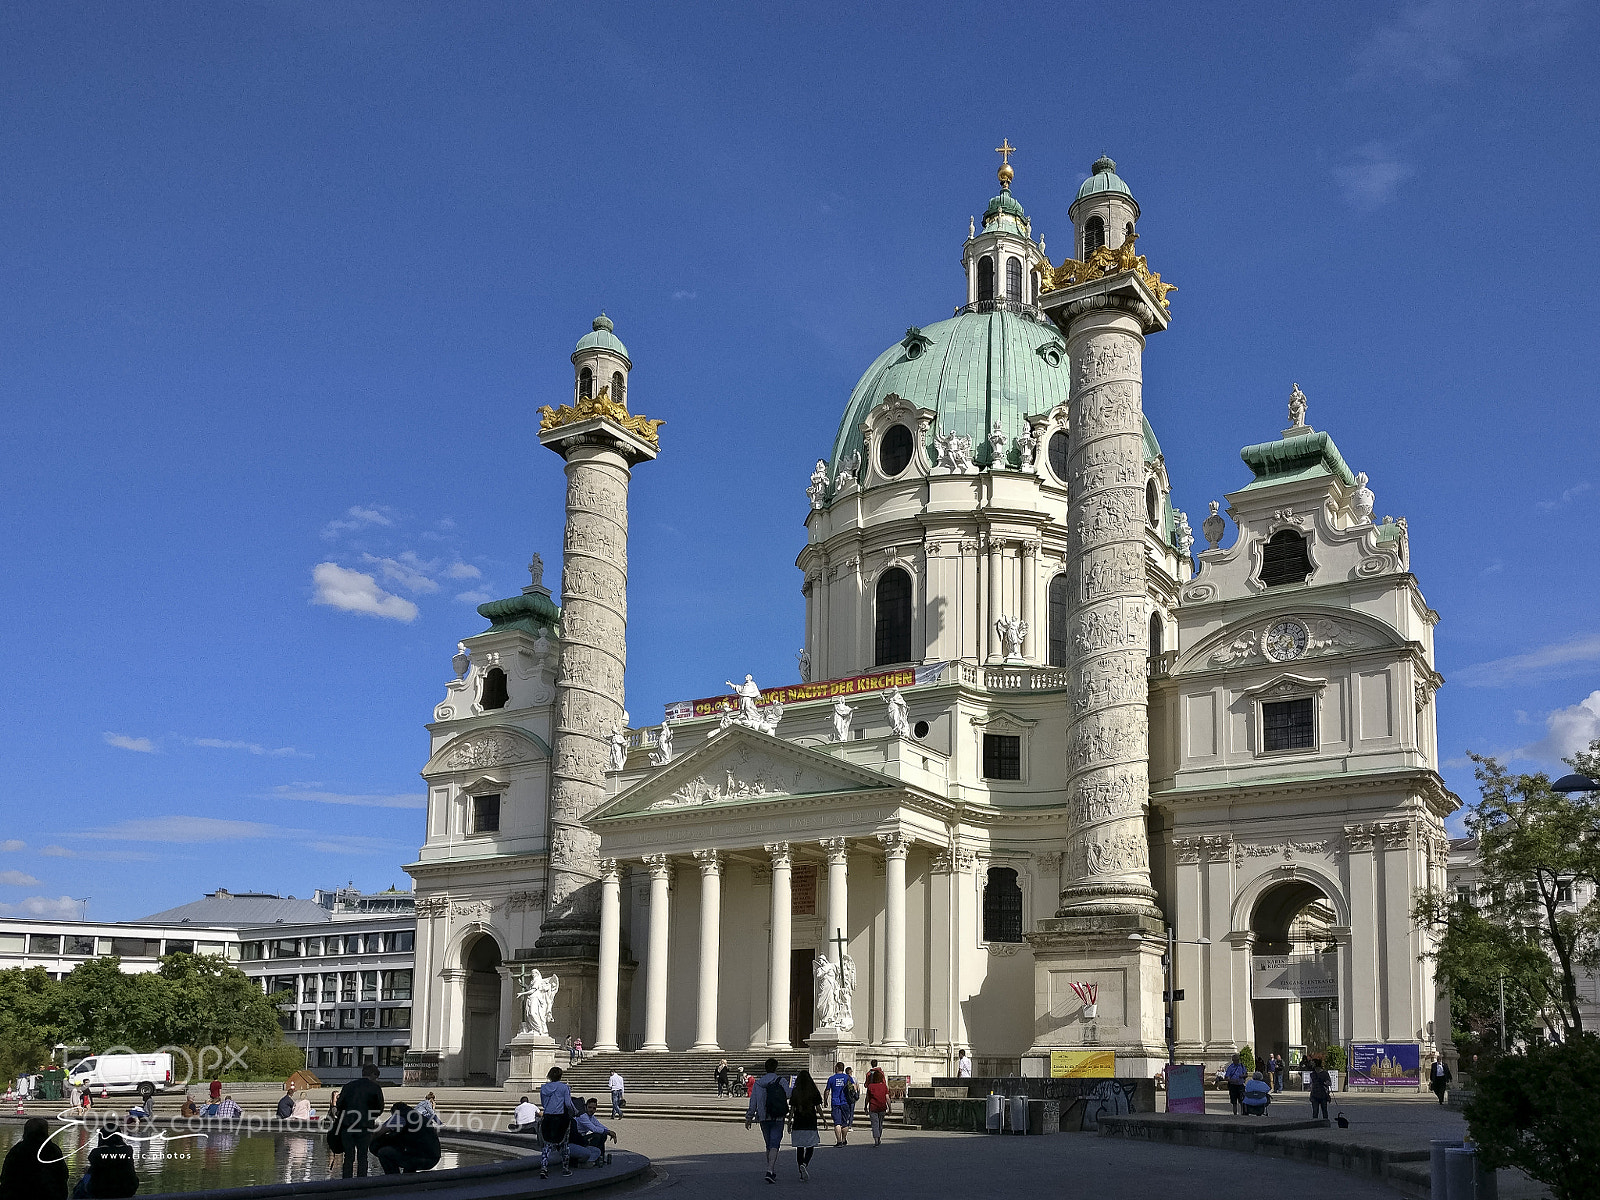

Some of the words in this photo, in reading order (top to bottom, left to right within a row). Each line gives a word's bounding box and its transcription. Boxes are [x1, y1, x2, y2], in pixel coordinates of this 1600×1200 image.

[788, 684, 828, 700] NACHT
[831, 681, 854, 696] DER
[857, 672, 913, 691] KIRCHEN
